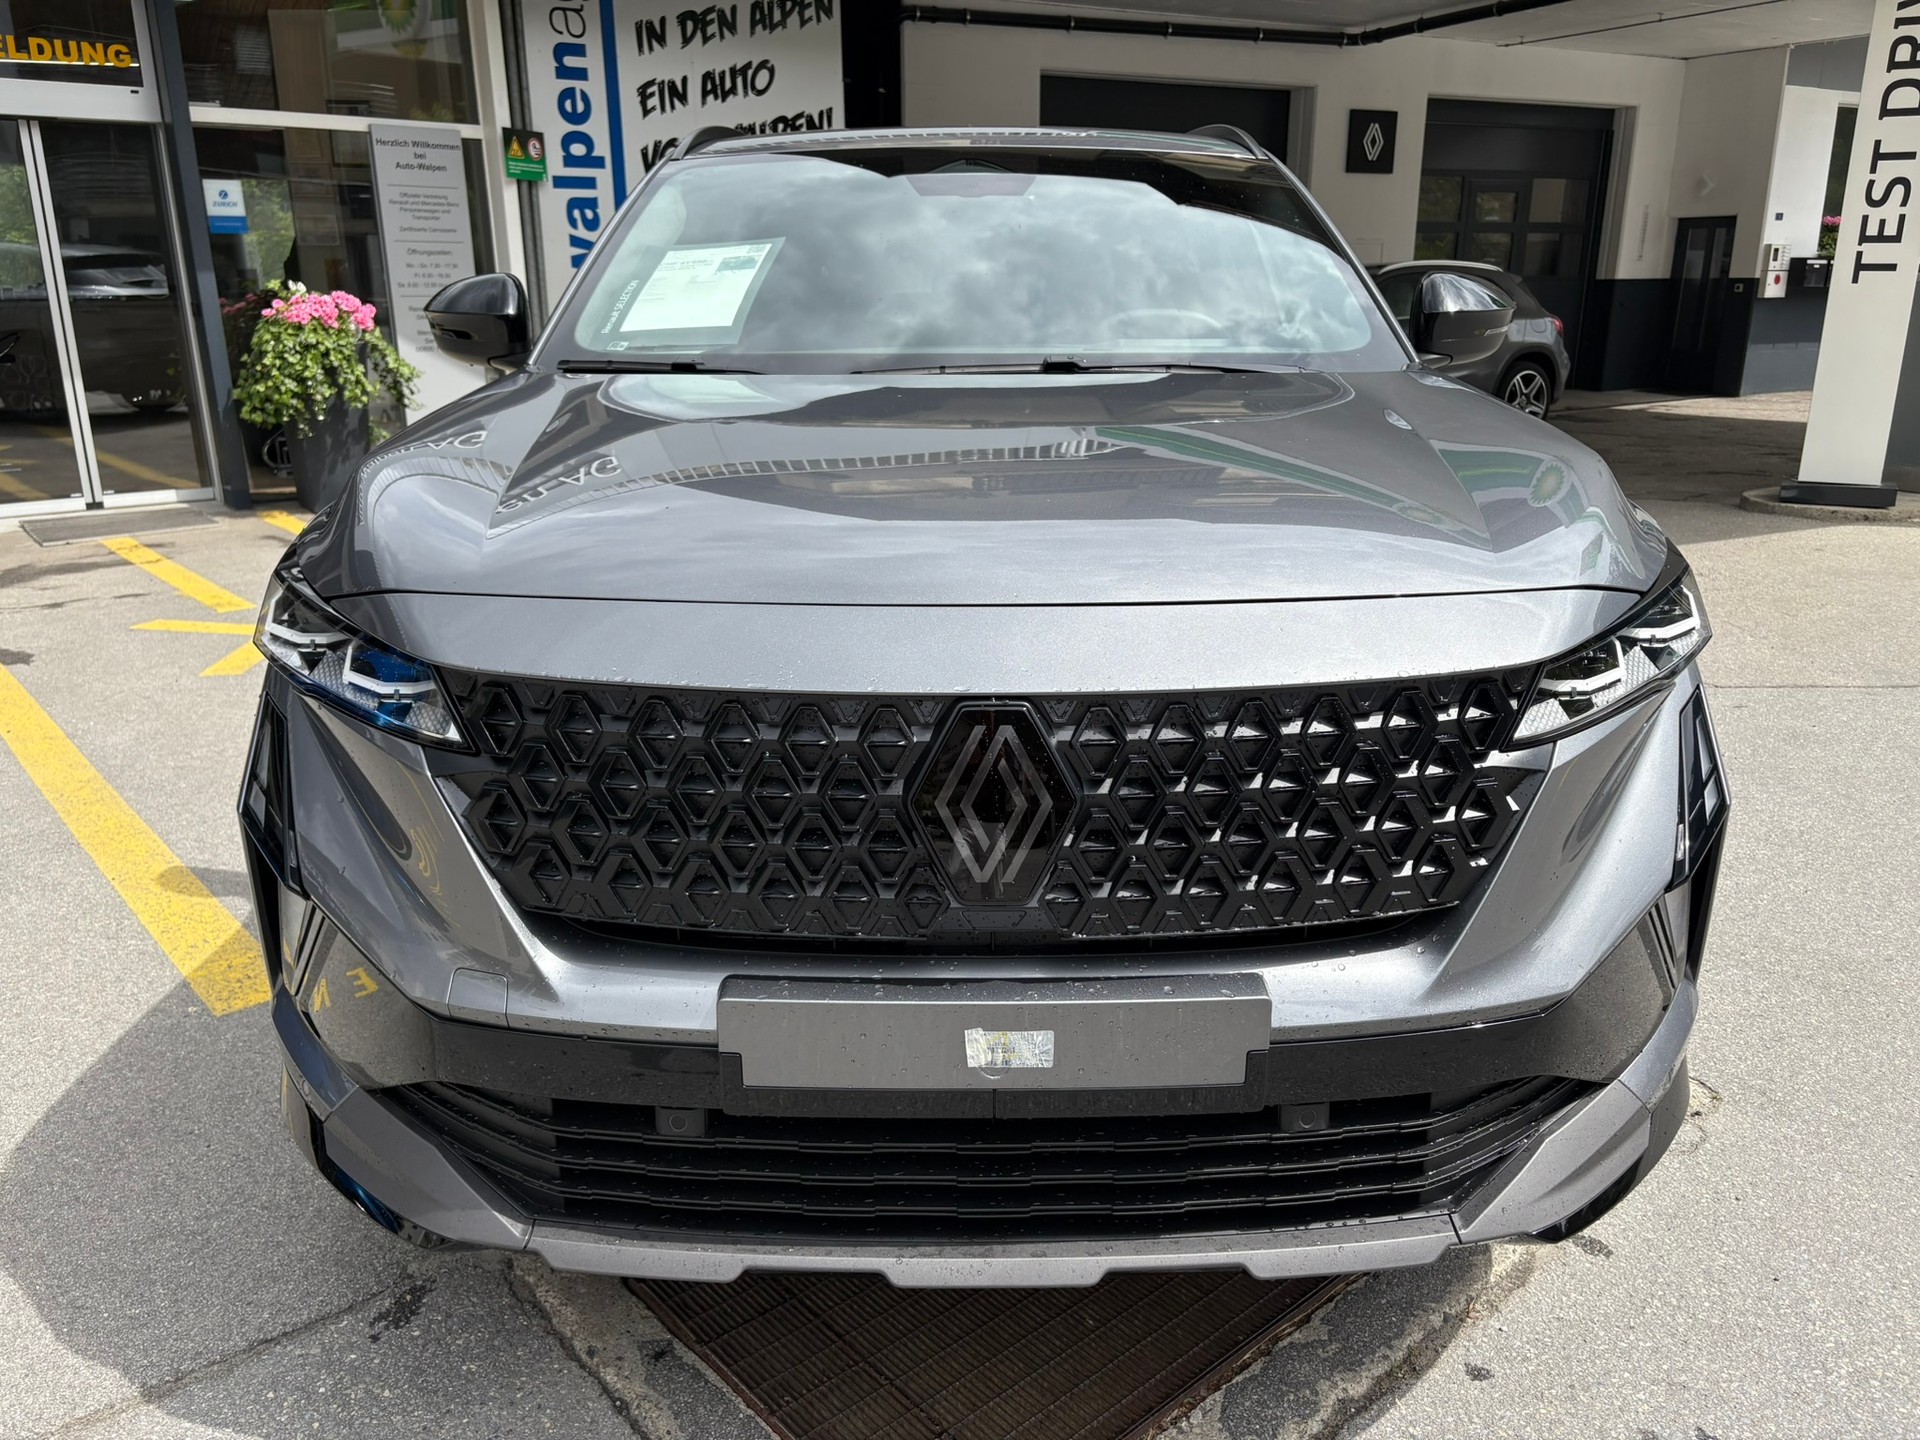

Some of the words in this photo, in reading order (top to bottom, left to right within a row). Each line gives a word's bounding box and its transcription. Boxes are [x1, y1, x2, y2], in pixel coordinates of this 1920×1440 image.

[635, 15, 668, 57] IN
[676, 4, 738, 50] DEN
[750, 0, 835, 38] ALPEN
[637, 74, 689, 120] EIN
[700, 58, 776, 107] AUTO
[1878, 0, 1920, 121] DRI
[375, 138, 410, 148] Herzlich
[411, 140, 461, 151] Willkommen
[395, 161, 447, 173] Auto-Walpen
[413, 152, 427, 160] bei
[1851, 138, 1918, 284] TEST
